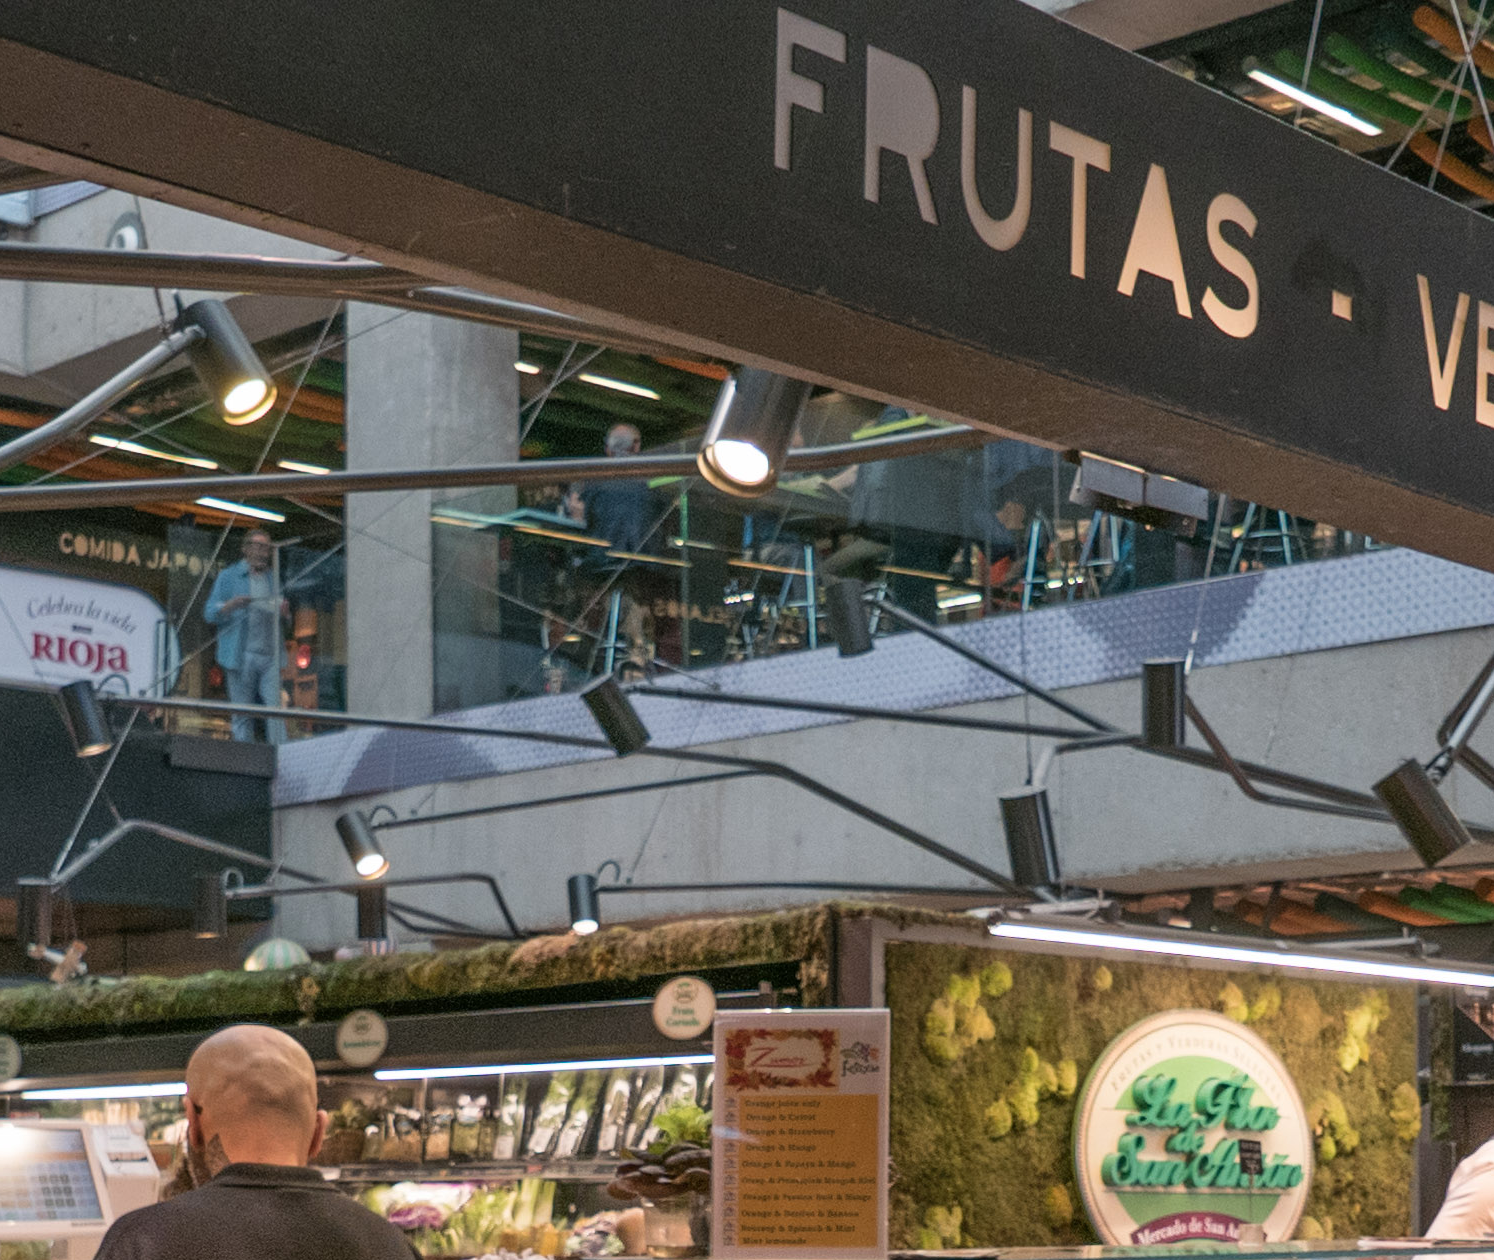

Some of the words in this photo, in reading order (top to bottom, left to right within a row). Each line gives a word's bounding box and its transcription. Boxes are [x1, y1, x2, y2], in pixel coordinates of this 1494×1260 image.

[774, 7, 1260, 339] FRUTAS
[59, 531, 141, 567] COMIDA
[27, 595, 85, 619] Celebra
[86, 600, 104, 618] la
[1137, 1218, 1189, 1246] Mercado
[1188, 1216, 1204, 1234] de
[1203, 1217, 1226, 1235] San
